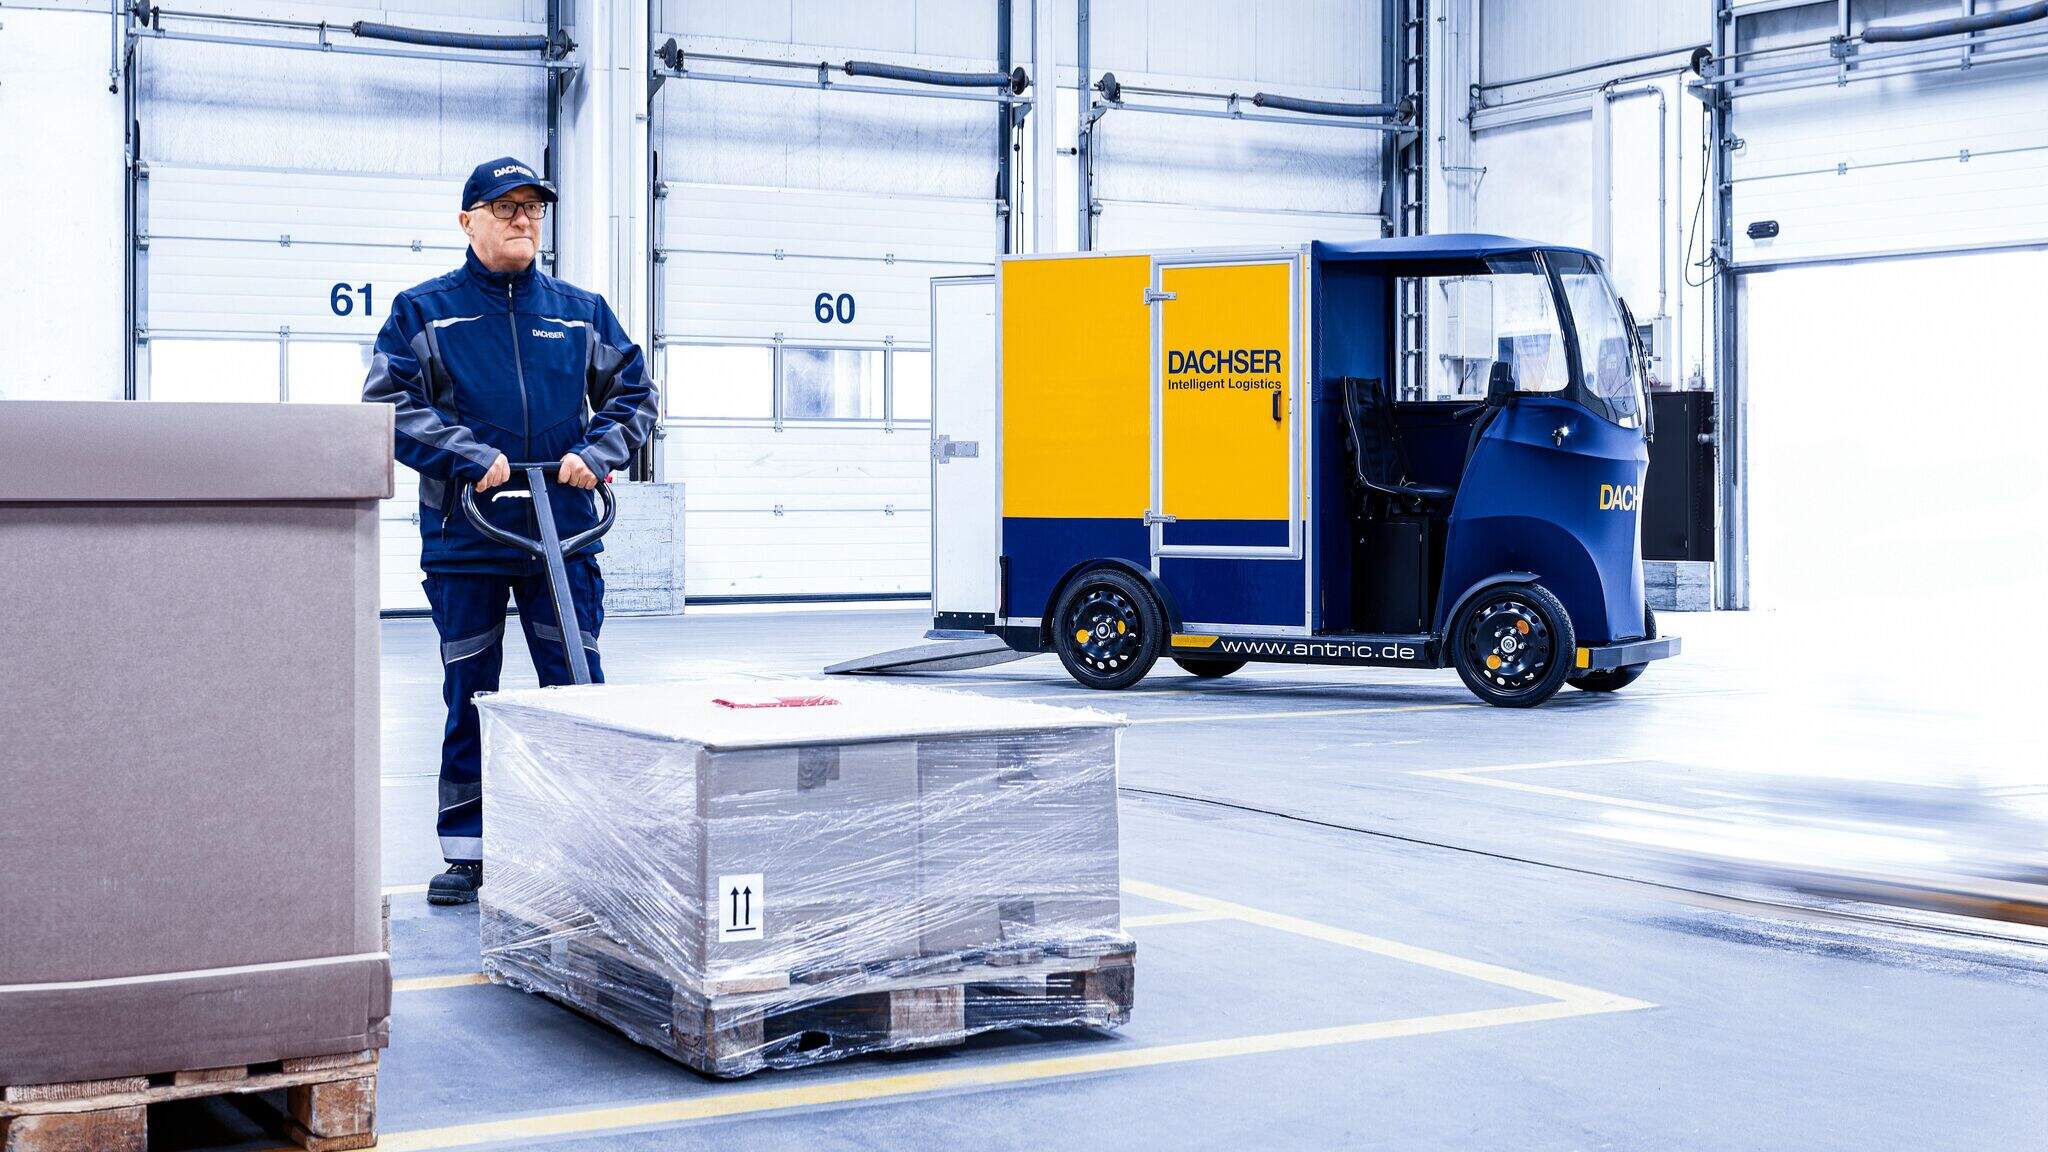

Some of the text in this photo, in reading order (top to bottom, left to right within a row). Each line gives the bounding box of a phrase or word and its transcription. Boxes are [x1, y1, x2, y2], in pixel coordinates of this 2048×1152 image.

[331, 282, 372, 316] 61
[815, 292, 855, 324] 60
[532, 329, 565, 339] DACHSER
[1168, 349, 1281, 374] DACHSER
[1168, 378, 1282, 392] Intelligent Logistics
[1221, 640, 1415, 660] www.antric.de
